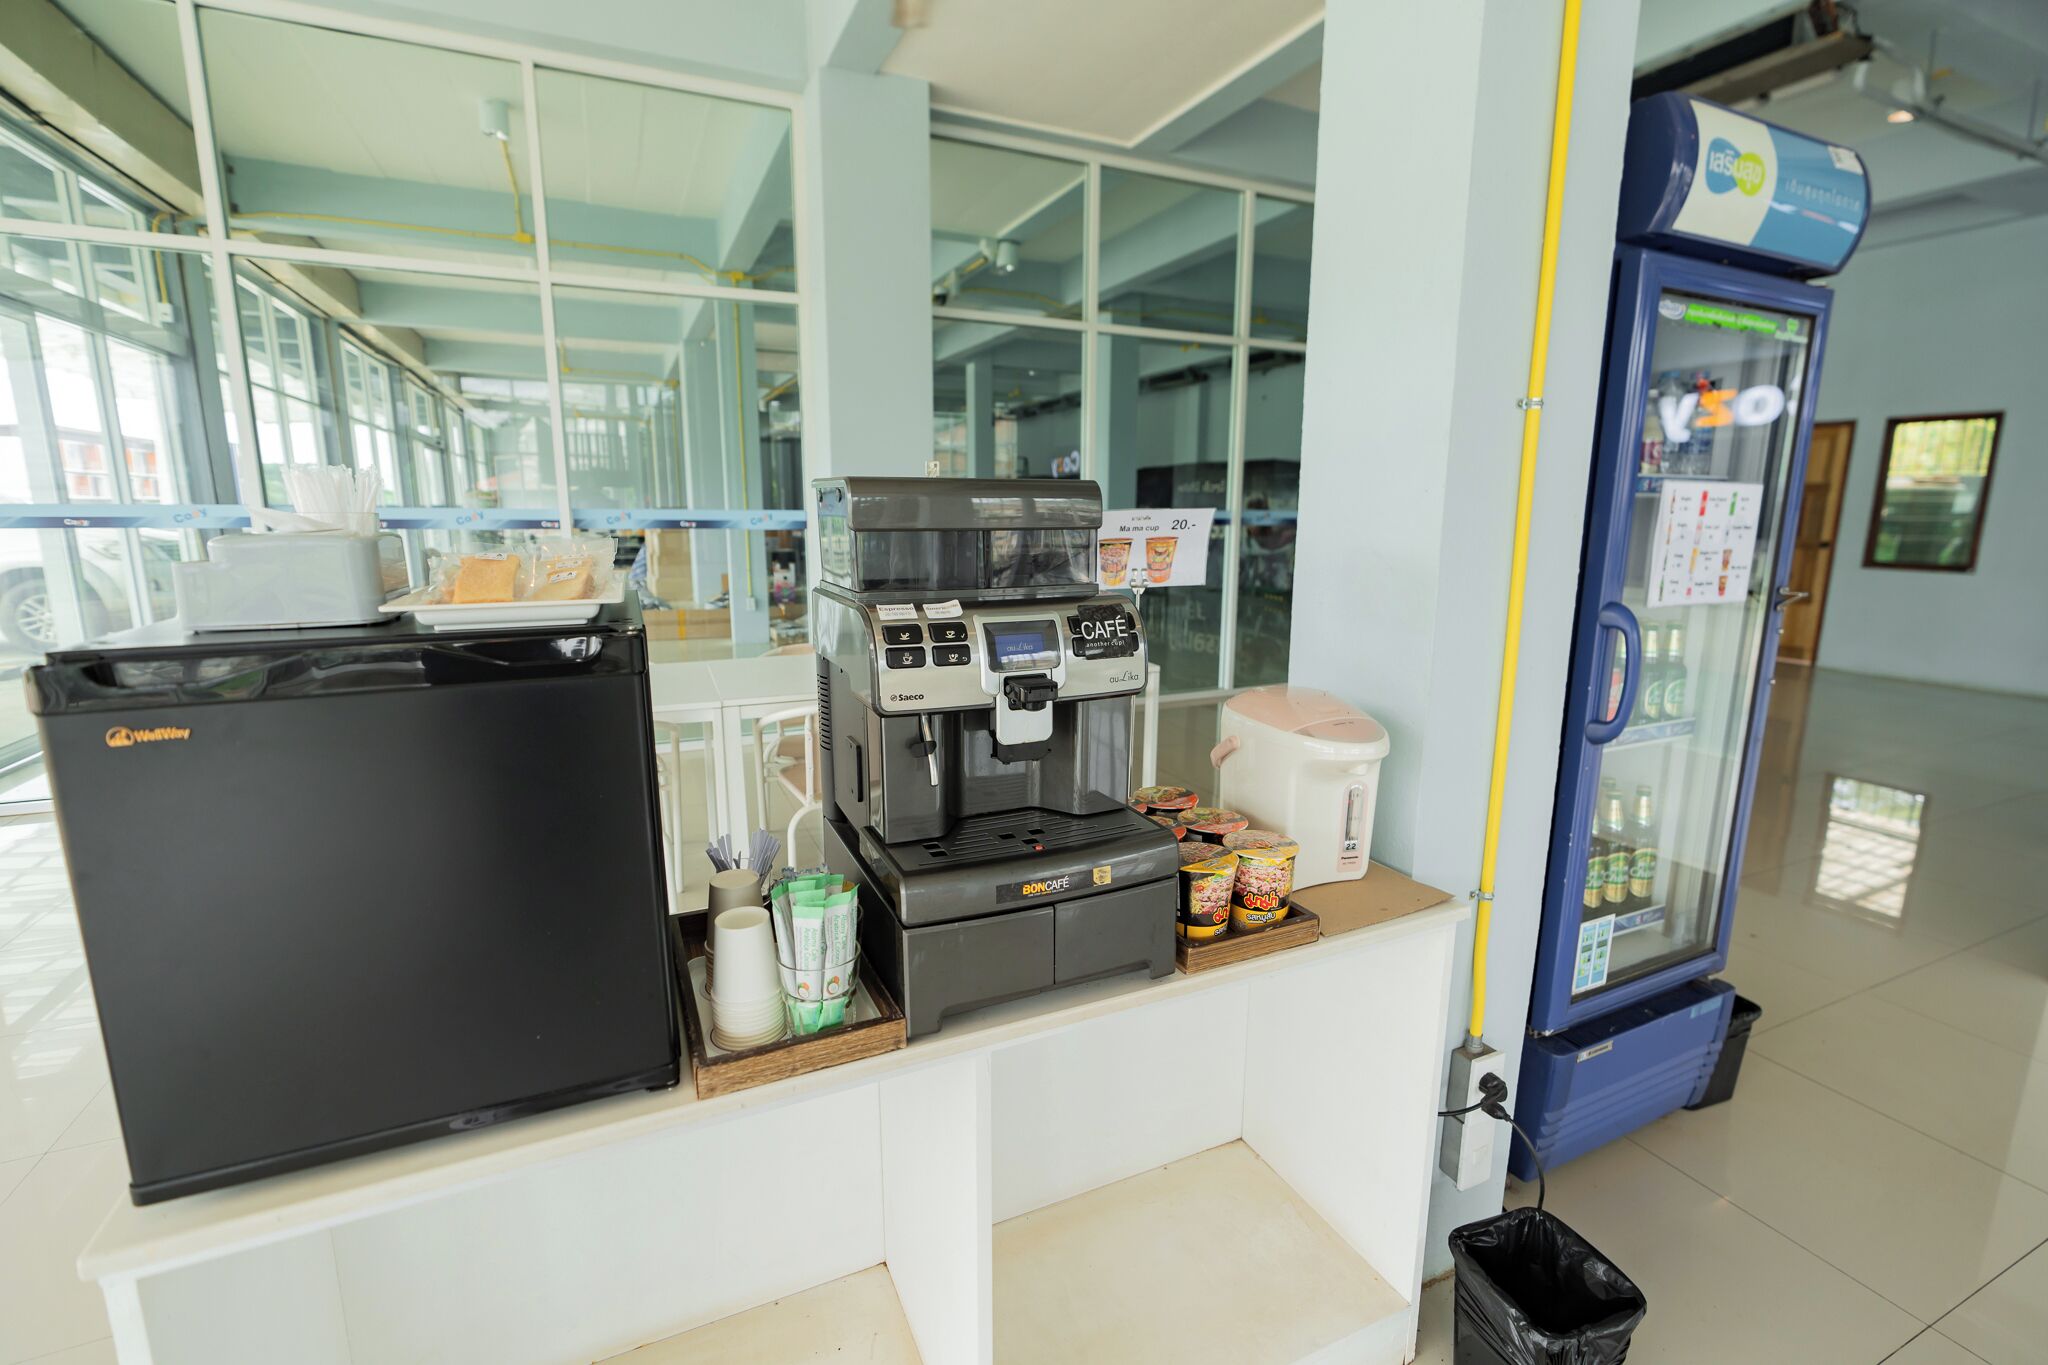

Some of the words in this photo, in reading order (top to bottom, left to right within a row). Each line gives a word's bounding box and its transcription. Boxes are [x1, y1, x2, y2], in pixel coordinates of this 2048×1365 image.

[1171, 519, 1197, 530] 20.-
[1081, 615, 1129, 640] CAFÉ
[898, 693, 925, 702] Saeco
[134, 727, 191, 743] WellWay
[1022, 875, 1070, 896] BONCAFÉ
[1244, 891, 1279, 910] มาม่า
[1246, 912, 1276, 924] รสหมูสับ
